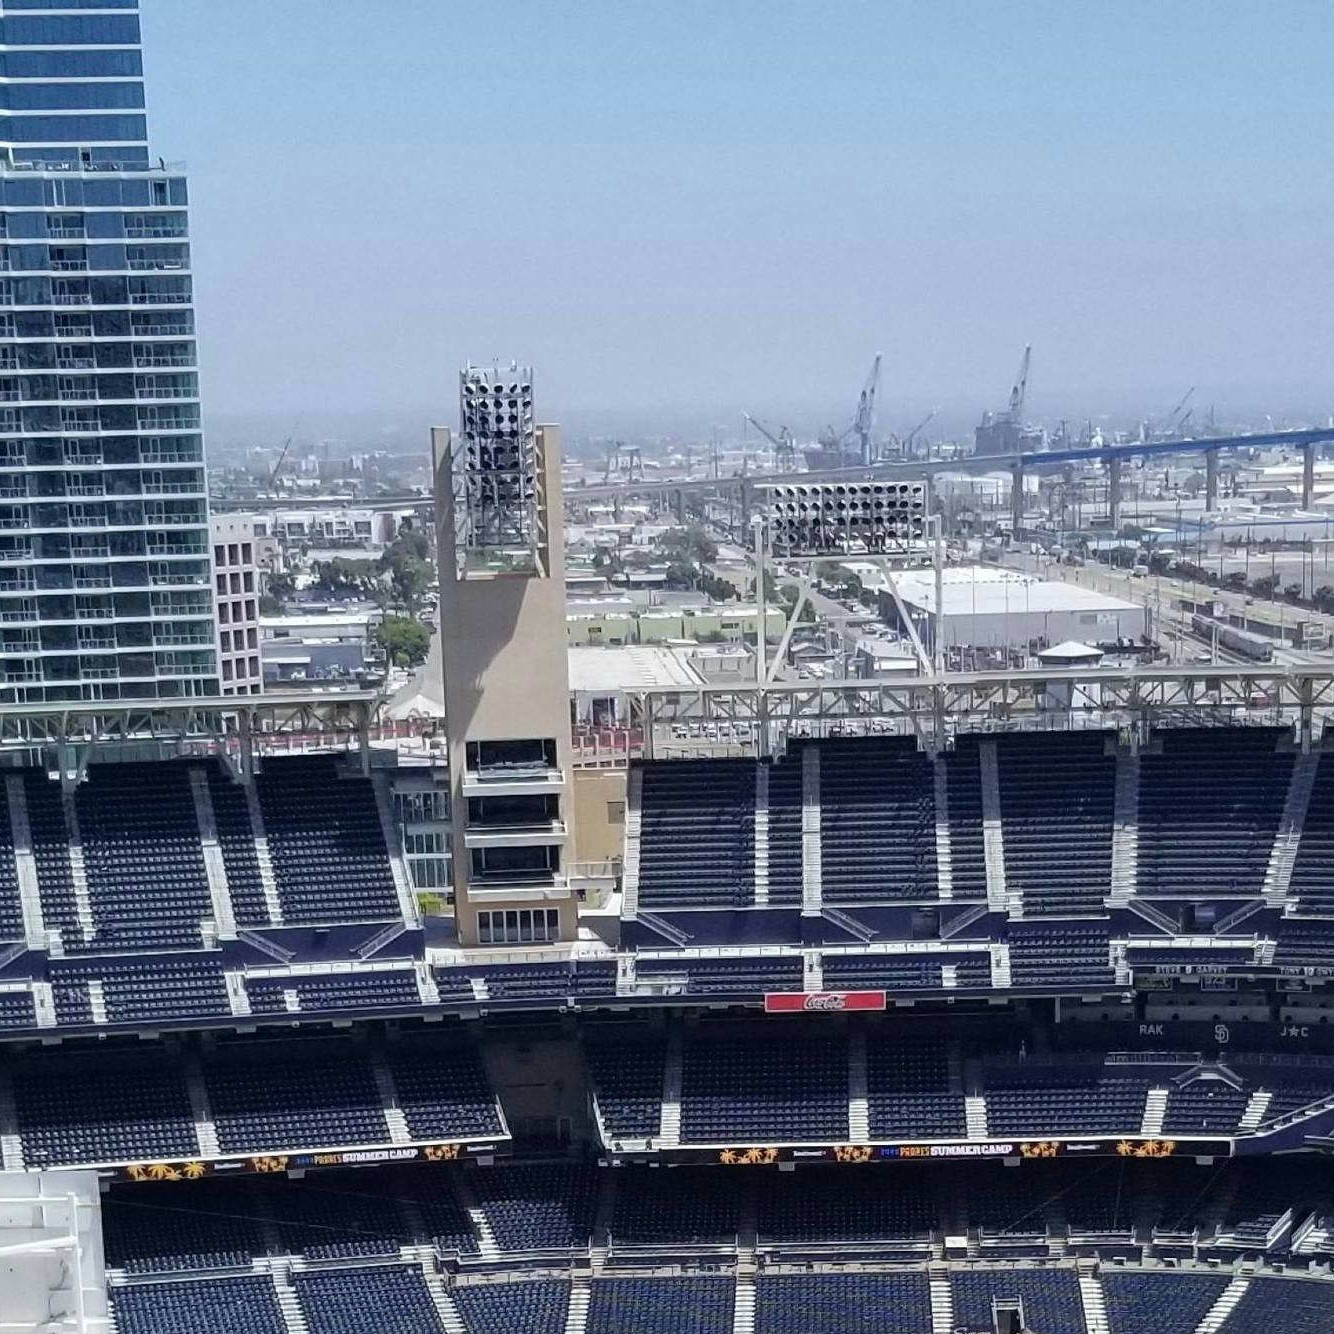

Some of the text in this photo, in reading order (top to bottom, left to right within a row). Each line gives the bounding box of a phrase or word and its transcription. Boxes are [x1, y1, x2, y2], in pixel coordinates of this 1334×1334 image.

[1139, 1024, 1164, 1036] RAK
[342, 1150, 389, 1164] SUMMER
[389, 1148, 419, 1160] CAMP
[930, 1145, 981, 1156] SUMMER
[981, 1145, 1013, 1155] CAMP
